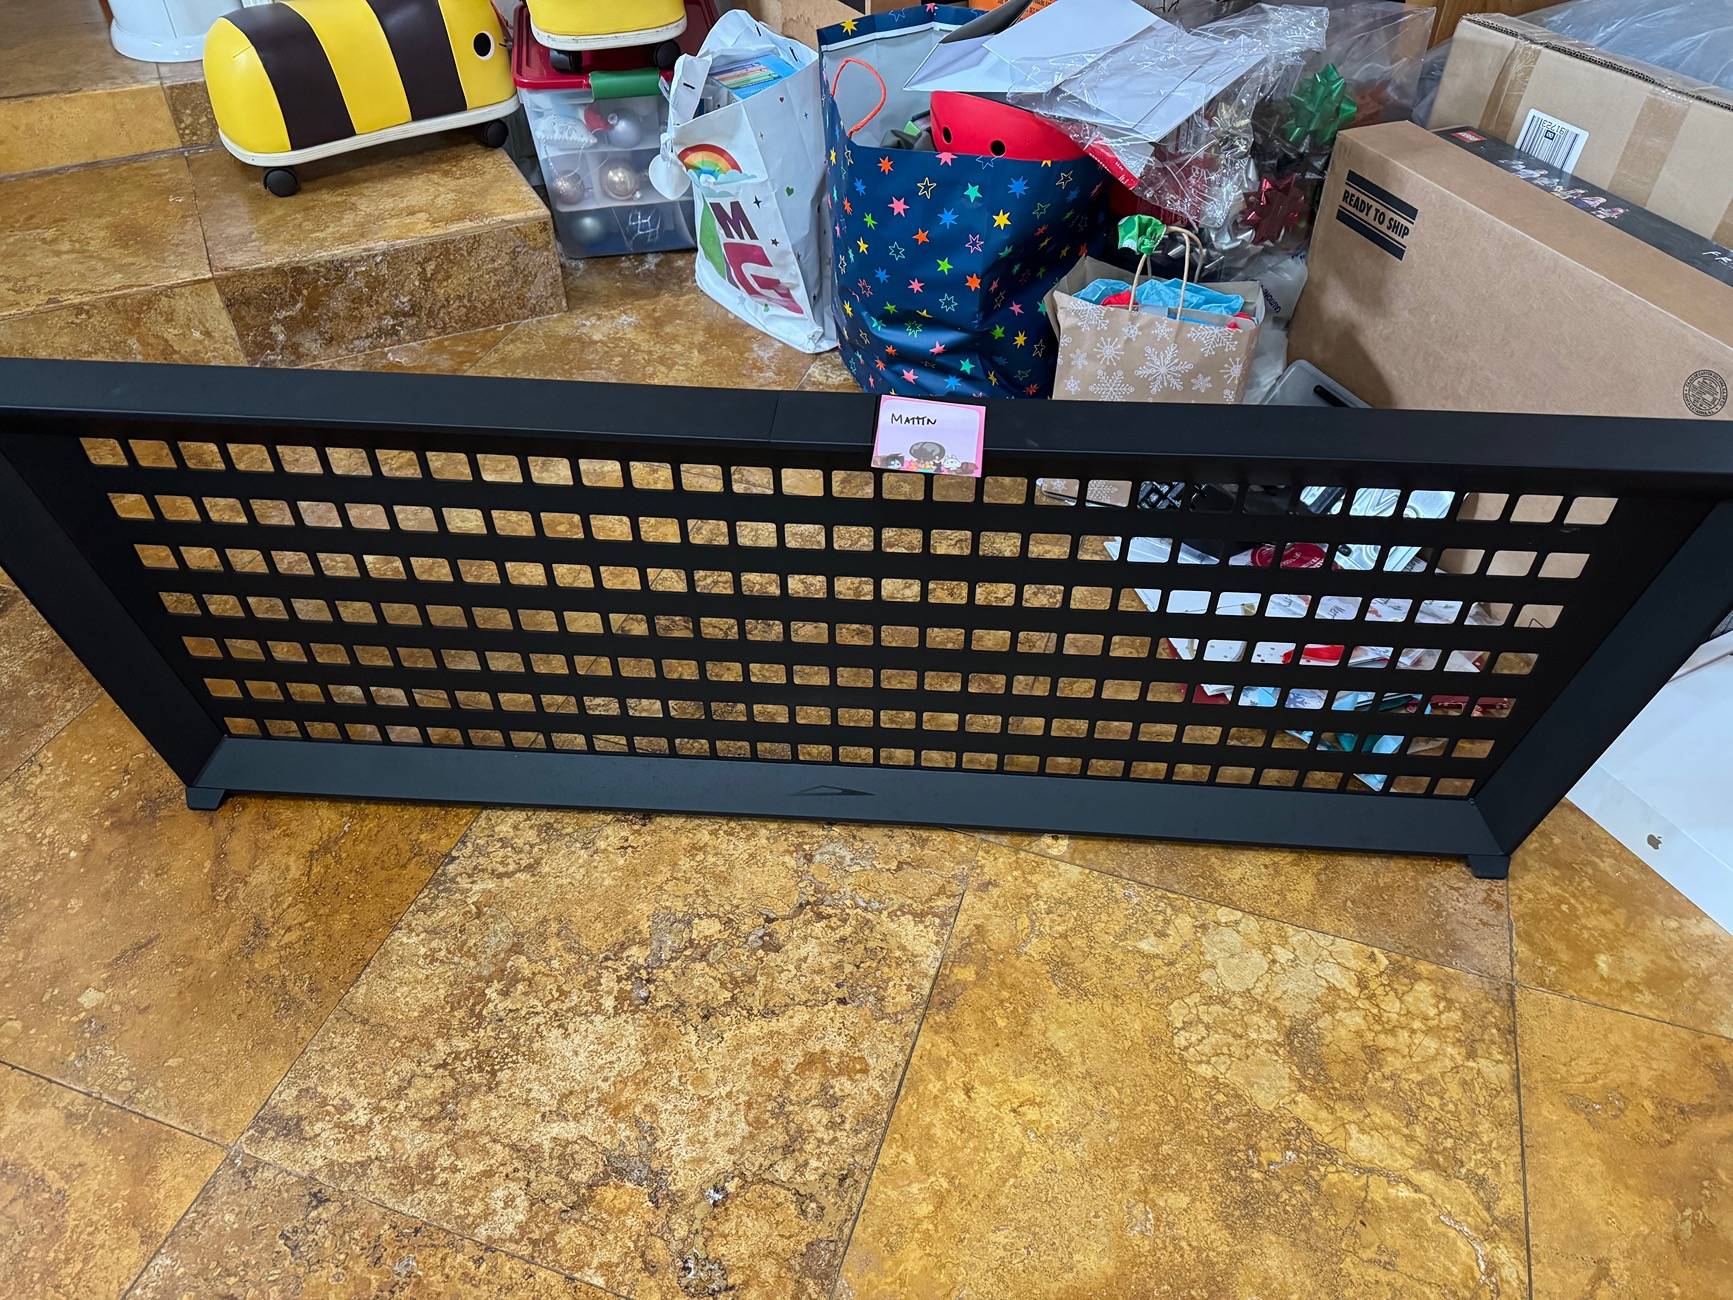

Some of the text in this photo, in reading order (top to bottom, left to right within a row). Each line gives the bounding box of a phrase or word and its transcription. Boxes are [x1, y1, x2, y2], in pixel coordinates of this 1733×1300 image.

[1342, 189, 1410, 239] READY TO SHIP
